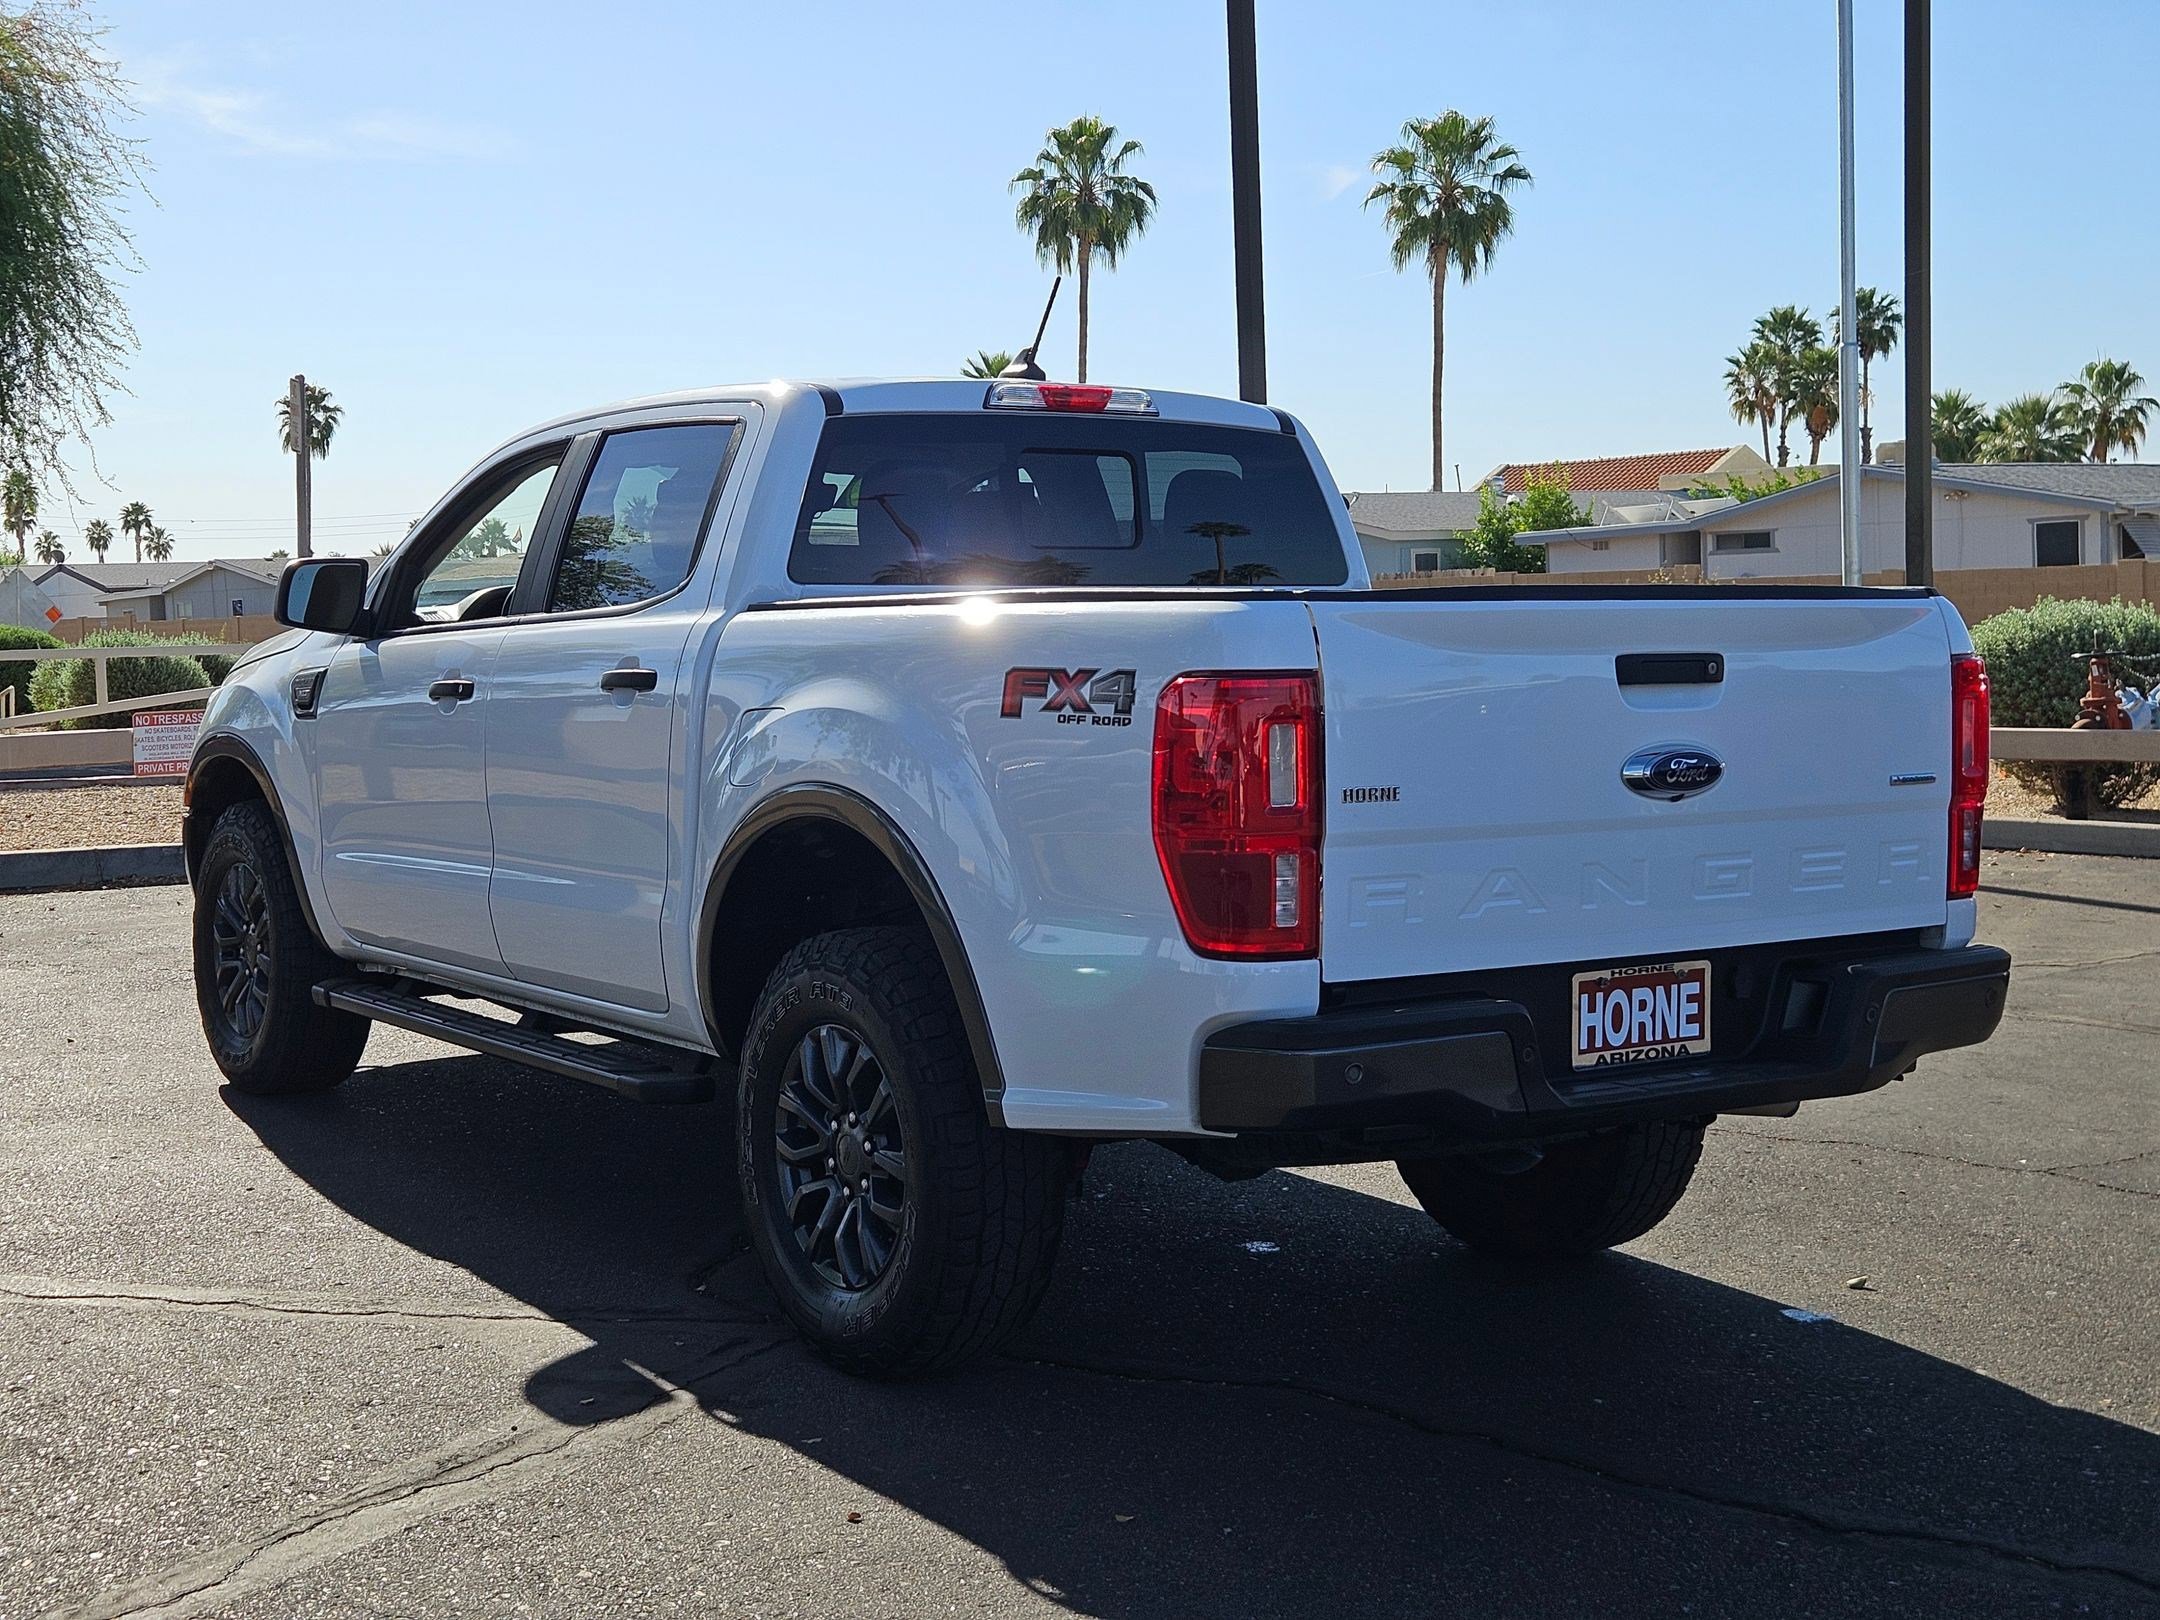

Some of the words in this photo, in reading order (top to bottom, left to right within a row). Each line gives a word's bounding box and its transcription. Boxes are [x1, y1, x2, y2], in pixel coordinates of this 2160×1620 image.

[1000, 666, 1138, 719] FX4
[135, 715, 150, 726] NO
[1057, 714, 1087, 725] OFF
[1091, 716, 1132, 727] ROAD
[137, 763, 175, 774] PRIVATE
[1666, 758, 1709, 783] Ford
[1341, 786, 1400, 804] HORNE
[1349, 837, 1932, 928] RANGER
[1610, 963, 1676, 977] HORNE
[1579, 981, 1701, 1050] HORNE
[1594, 1043, 1692, 1066] ARIZONA
